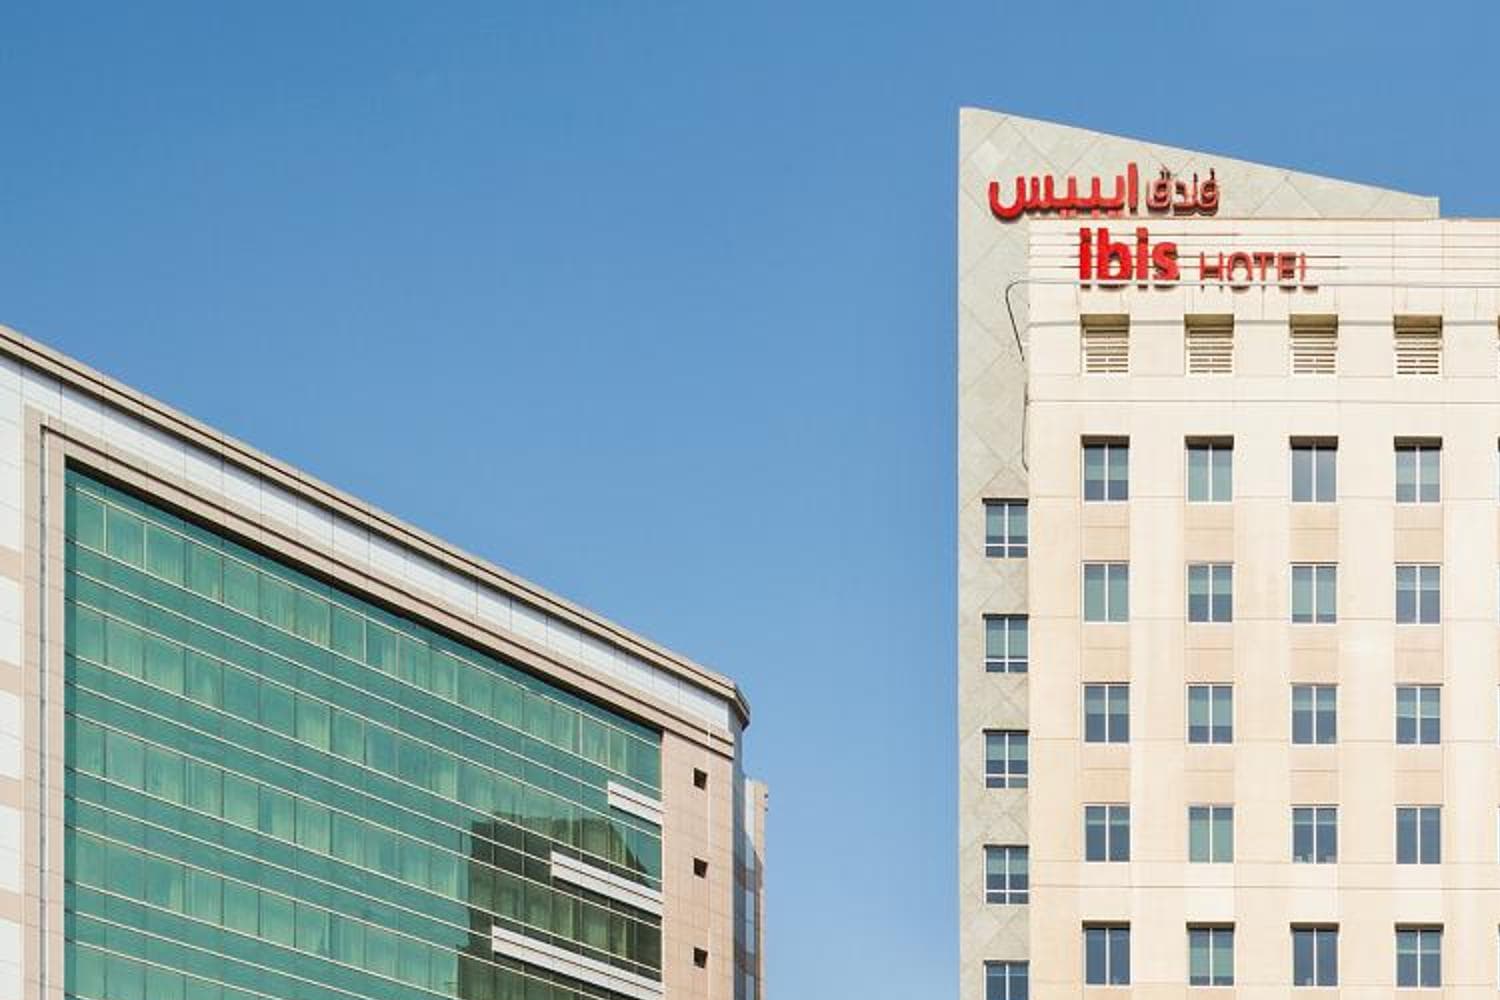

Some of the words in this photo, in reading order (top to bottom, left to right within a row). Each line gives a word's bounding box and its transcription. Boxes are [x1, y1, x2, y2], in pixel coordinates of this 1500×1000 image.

[1146, 168, 1219, 216] فندق
[1079, 227, 1181, 289] ibis
[1200, 252, 1319, 291] HOTEL
